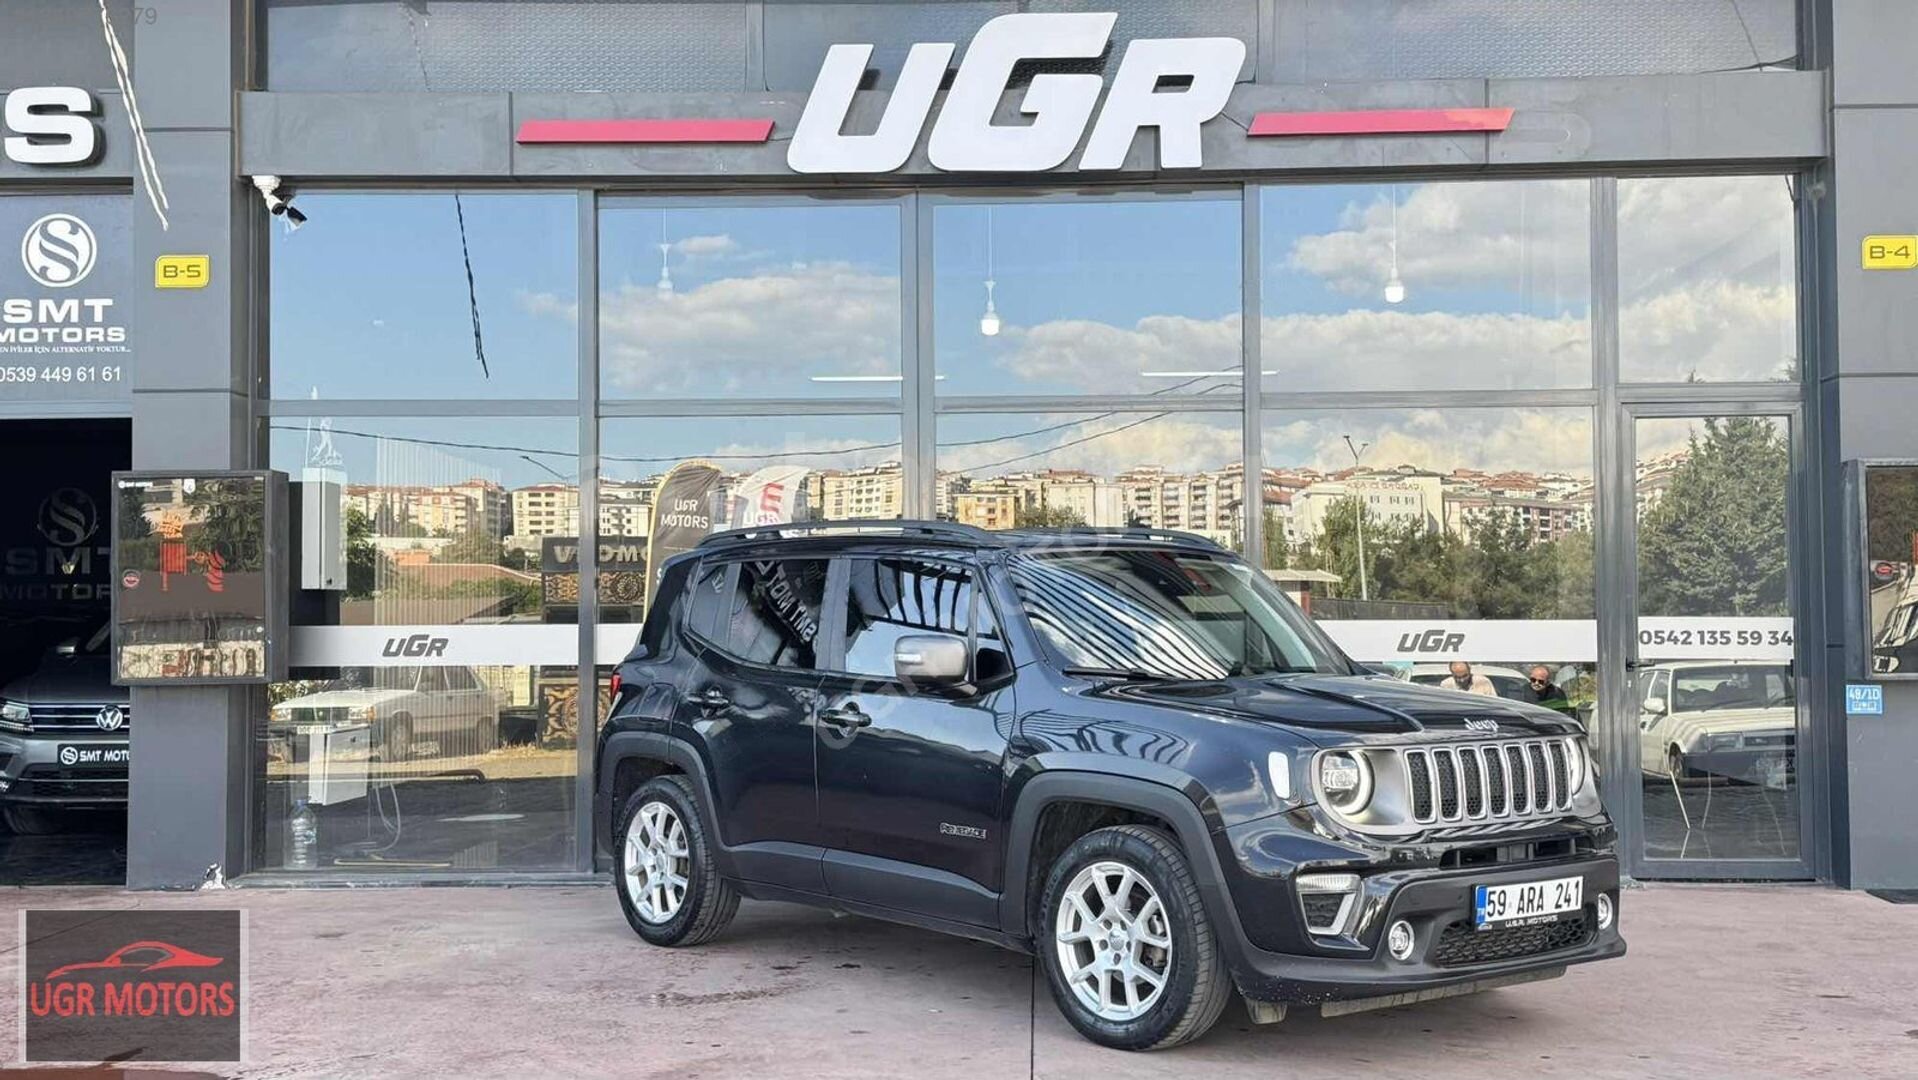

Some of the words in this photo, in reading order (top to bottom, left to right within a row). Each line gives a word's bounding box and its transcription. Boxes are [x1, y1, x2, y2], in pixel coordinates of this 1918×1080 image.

[787, 12, 1247, 174] UGR
[4, 86, 95, 163] S
[1870, 245, 1910, 259] B-4
[3, 298, 113, 323] SMT
[41, 366, 72, 382] 449
[76, 366, 95, 382] 61
[102, 366, 121, 382] 61
[660, 514, 709, 529] MOTORS
[382, 634, 449, 657] UGR
[1396, 629, 1465, 652] UGR
[1639, 630, 1692, 646] 0542
[1697, 630, 1731, 646] 135
[1736, 630, 1763, 646] 59
[1767, 630, 1794, 646] 34
[79, 749, 102, 762] SMT
[1487, 890, 1507, 917] 59
[1517, 885, 1544, 915] ARA
[1554, 880, 1580, 910] 241
